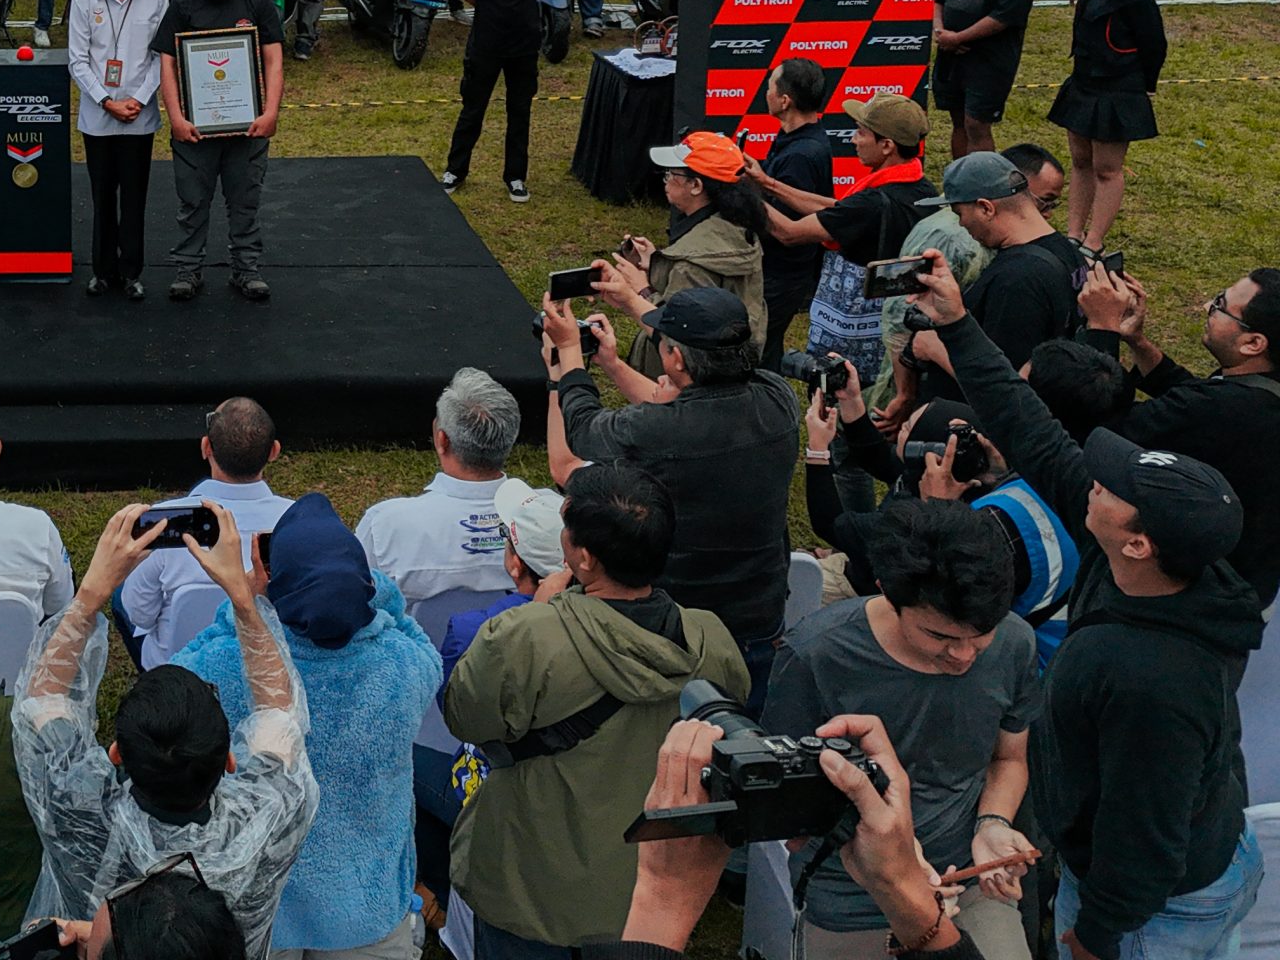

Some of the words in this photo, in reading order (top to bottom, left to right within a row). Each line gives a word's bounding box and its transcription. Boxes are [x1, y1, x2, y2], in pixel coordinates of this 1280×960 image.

[790, 41, 848, 51] POLYTRON
[706, 88, 745, 97] YTRON
[845, 85, 903, 95] POLYTRON
[0, 95, 49, 104] POLYTRON
[6, 131, 43, 143] MURI
[818, 310, 855, 330] POLYTRON
